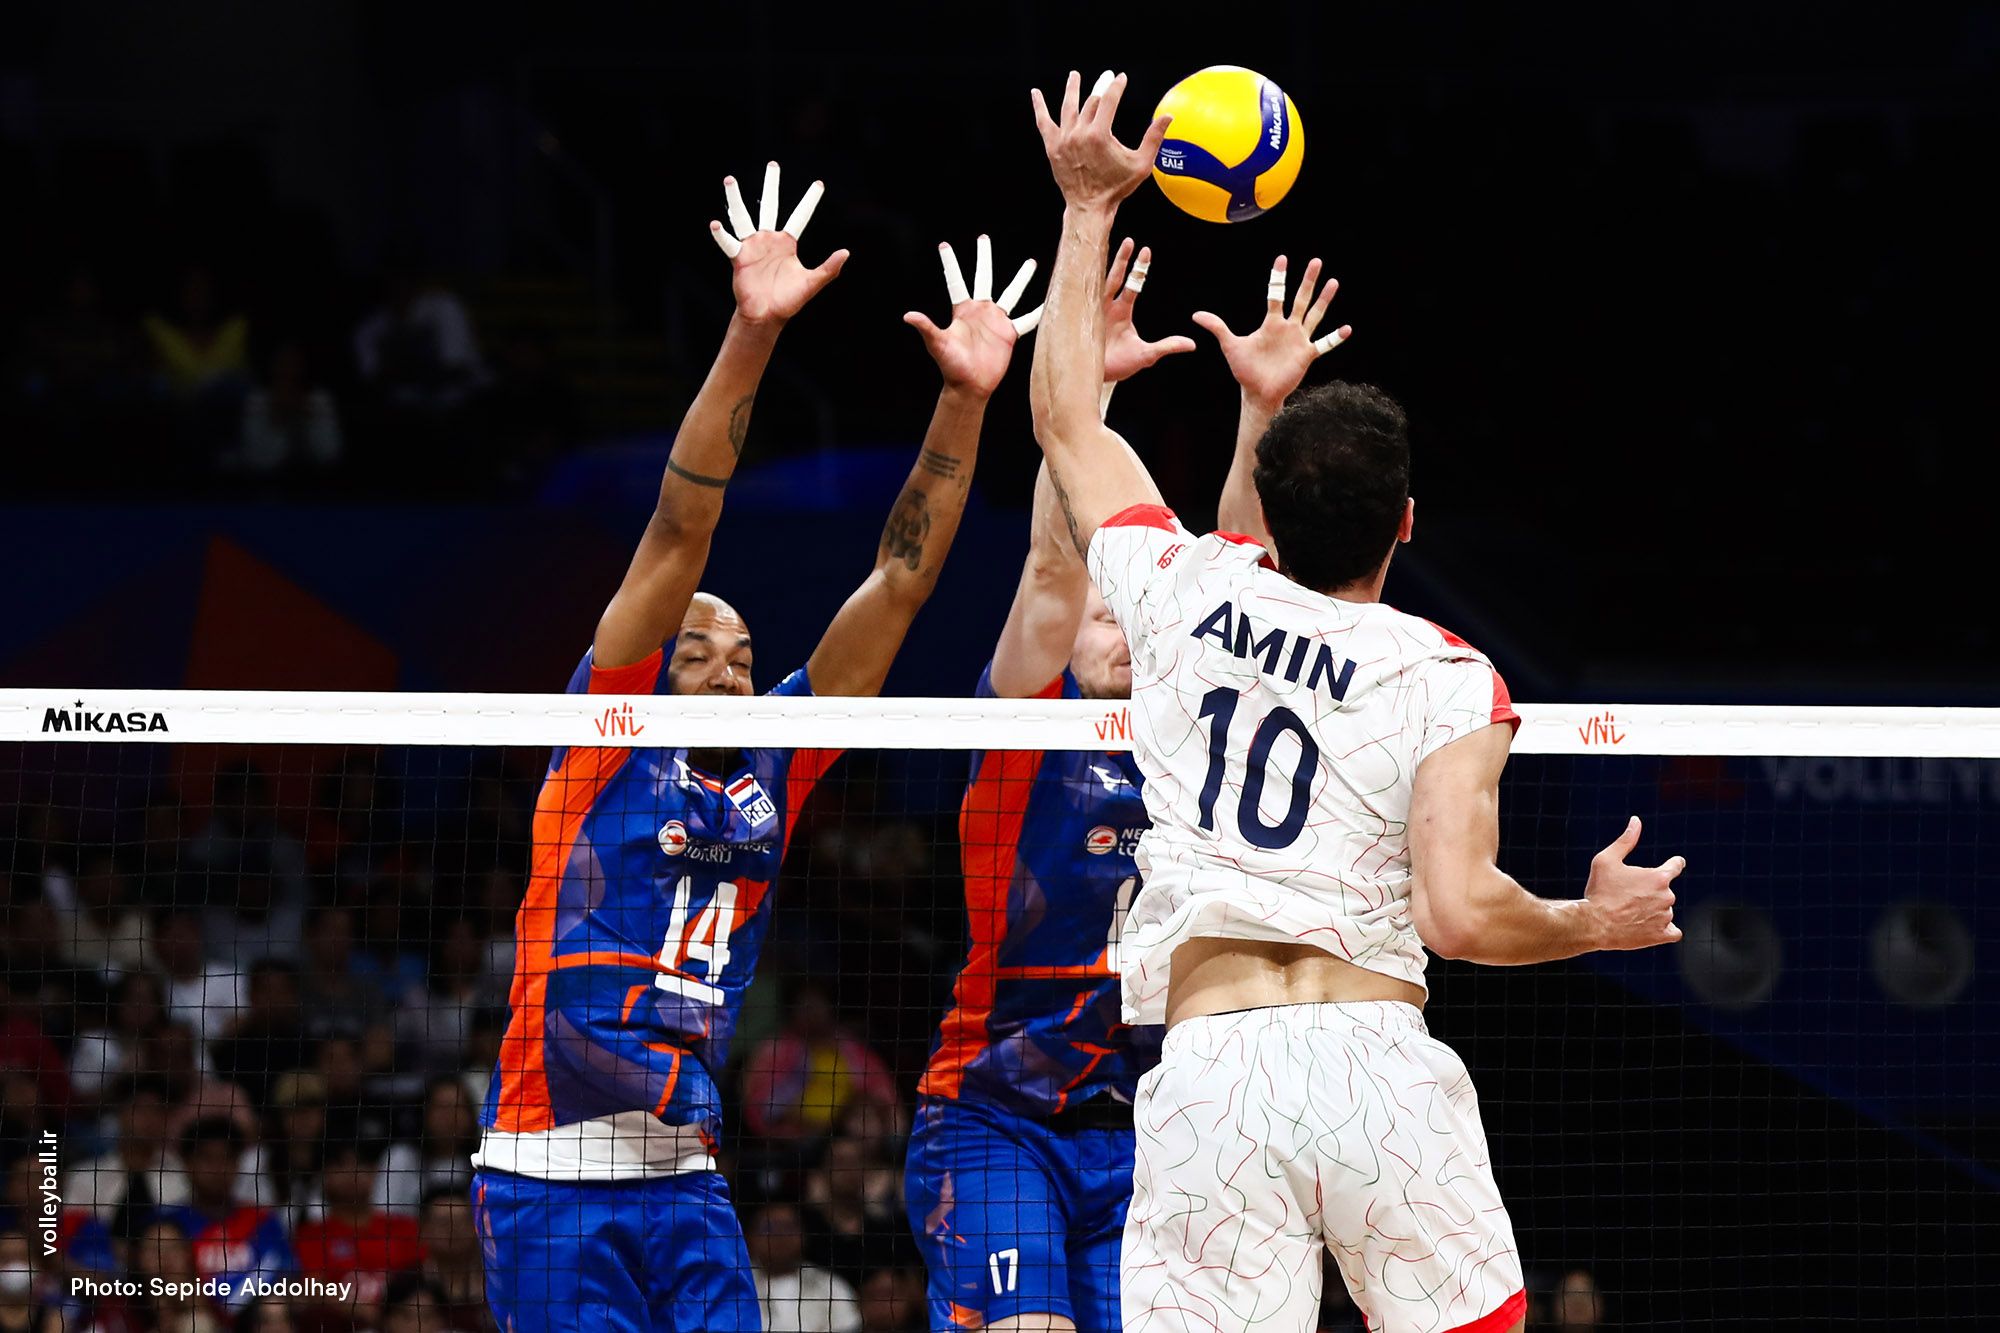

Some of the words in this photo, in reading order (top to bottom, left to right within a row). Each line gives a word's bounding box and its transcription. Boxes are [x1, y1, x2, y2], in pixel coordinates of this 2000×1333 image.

[1161, 156, 1184, 170] FIVB
[1190, 600, 1357, 702] AMIN
[41, 699, 169, 733] MIKASA
[594, 702, 645, 737] VNL
[1578, 711, 1626, 745] VNL
[1198, 686, 1319, 850] 10
[659, 875, 738, 984] 14
[989, 1248, 1019, 1296] 17
